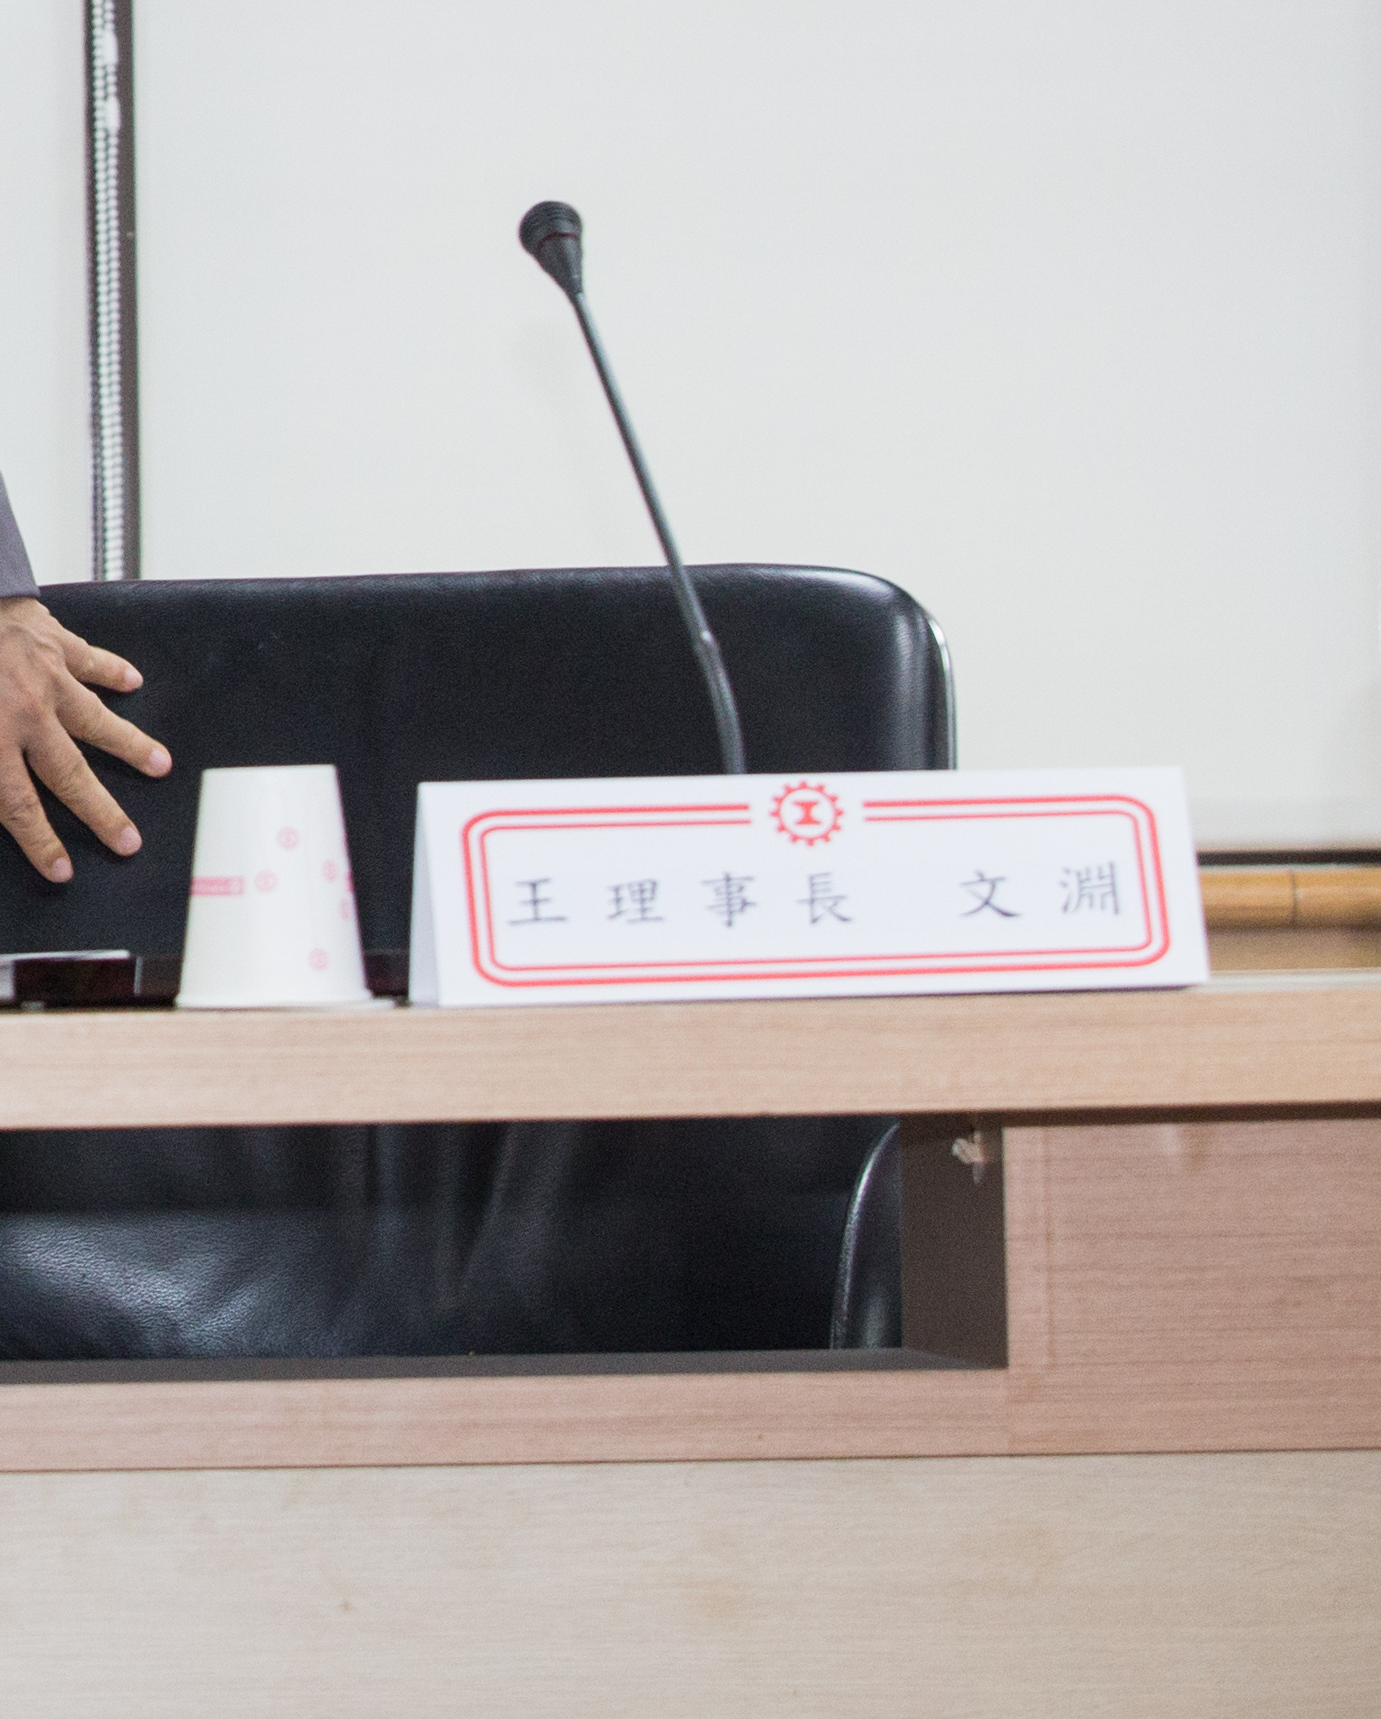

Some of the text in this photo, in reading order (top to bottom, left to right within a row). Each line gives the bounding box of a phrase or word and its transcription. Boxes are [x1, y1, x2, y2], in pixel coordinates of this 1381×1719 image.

[508, 860, 1122, 928] 王理事長 文淵
